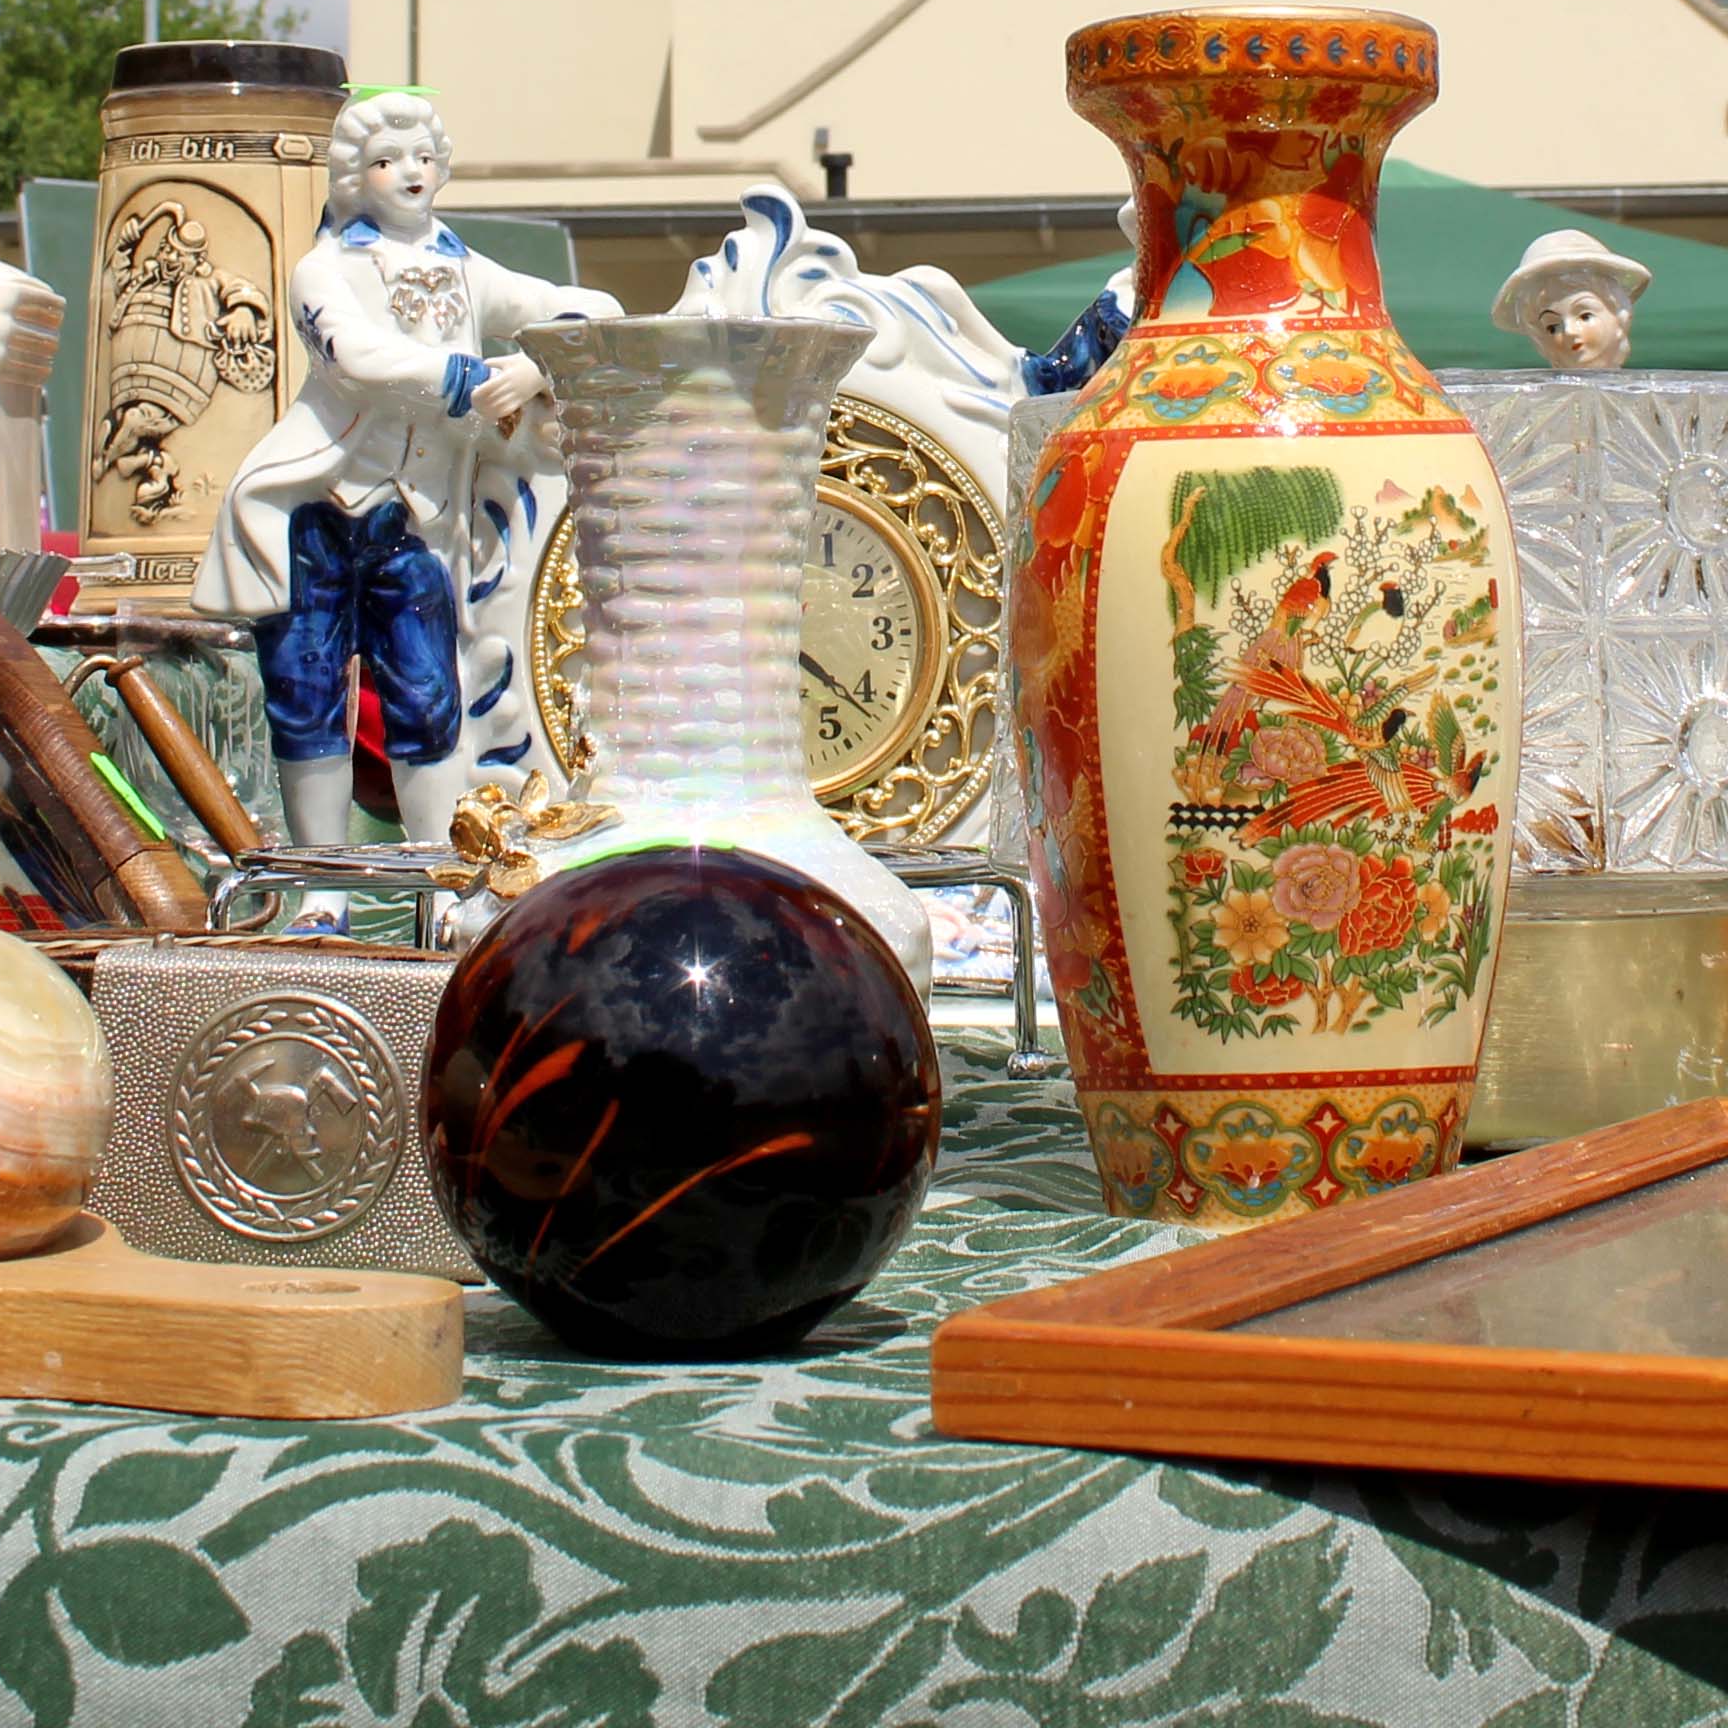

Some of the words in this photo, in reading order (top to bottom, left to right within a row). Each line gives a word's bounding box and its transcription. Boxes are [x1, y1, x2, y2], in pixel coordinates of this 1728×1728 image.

[130, 140, 160, 161] ich
[181, 136, 235, 161] bin
[822, 532, 836, 568] 1
[851, 563, 875, 599] 2
[871, 616, 894, 651] 3
[853, 669, 877, 703] 4
[818, 704, 842, 740] 5
